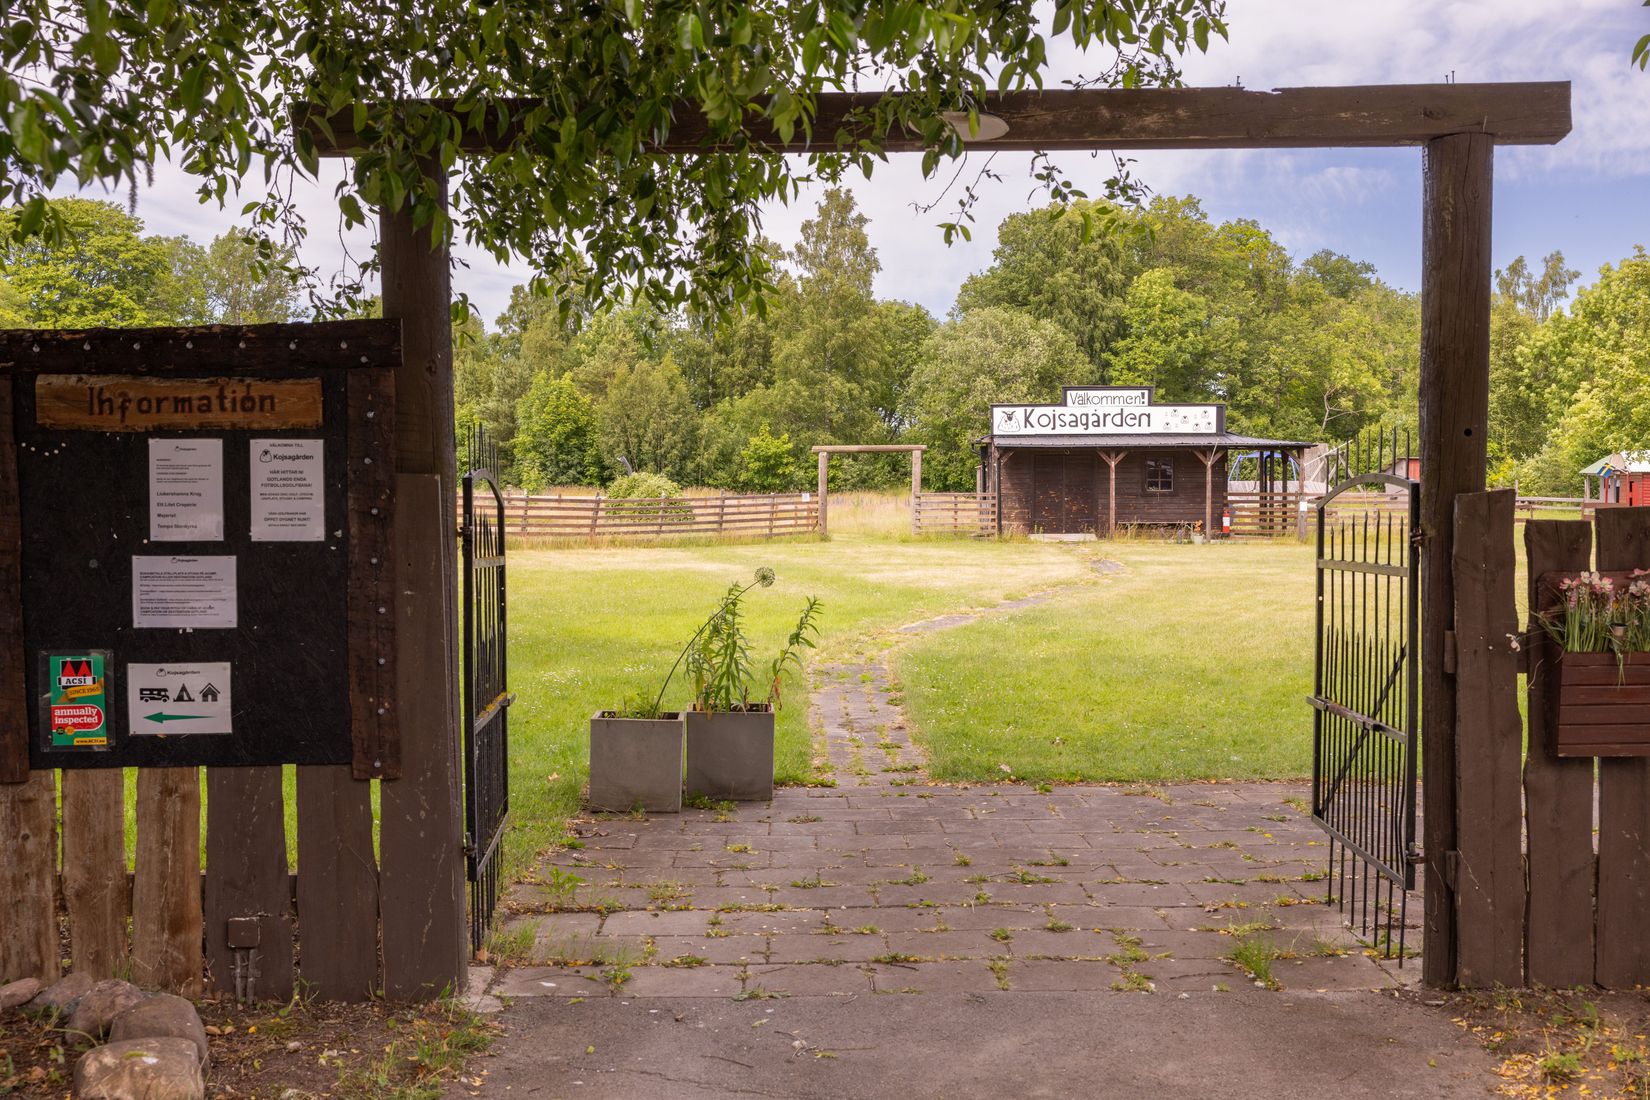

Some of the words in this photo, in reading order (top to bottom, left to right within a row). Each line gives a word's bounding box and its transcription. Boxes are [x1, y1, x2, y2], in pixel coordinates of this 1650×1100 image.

[86, 384, 276, 424] Information
[1069, 391, 1146, 406] Välkommen!
[1023, 408, 1151, 431] Kojsagården
[273, 453, 314, 462] Kojsagården
[65, 674, 87, 685] ACSI
[54, 706, 98, 717] annually
[55, 715, 98, 725] inspected
